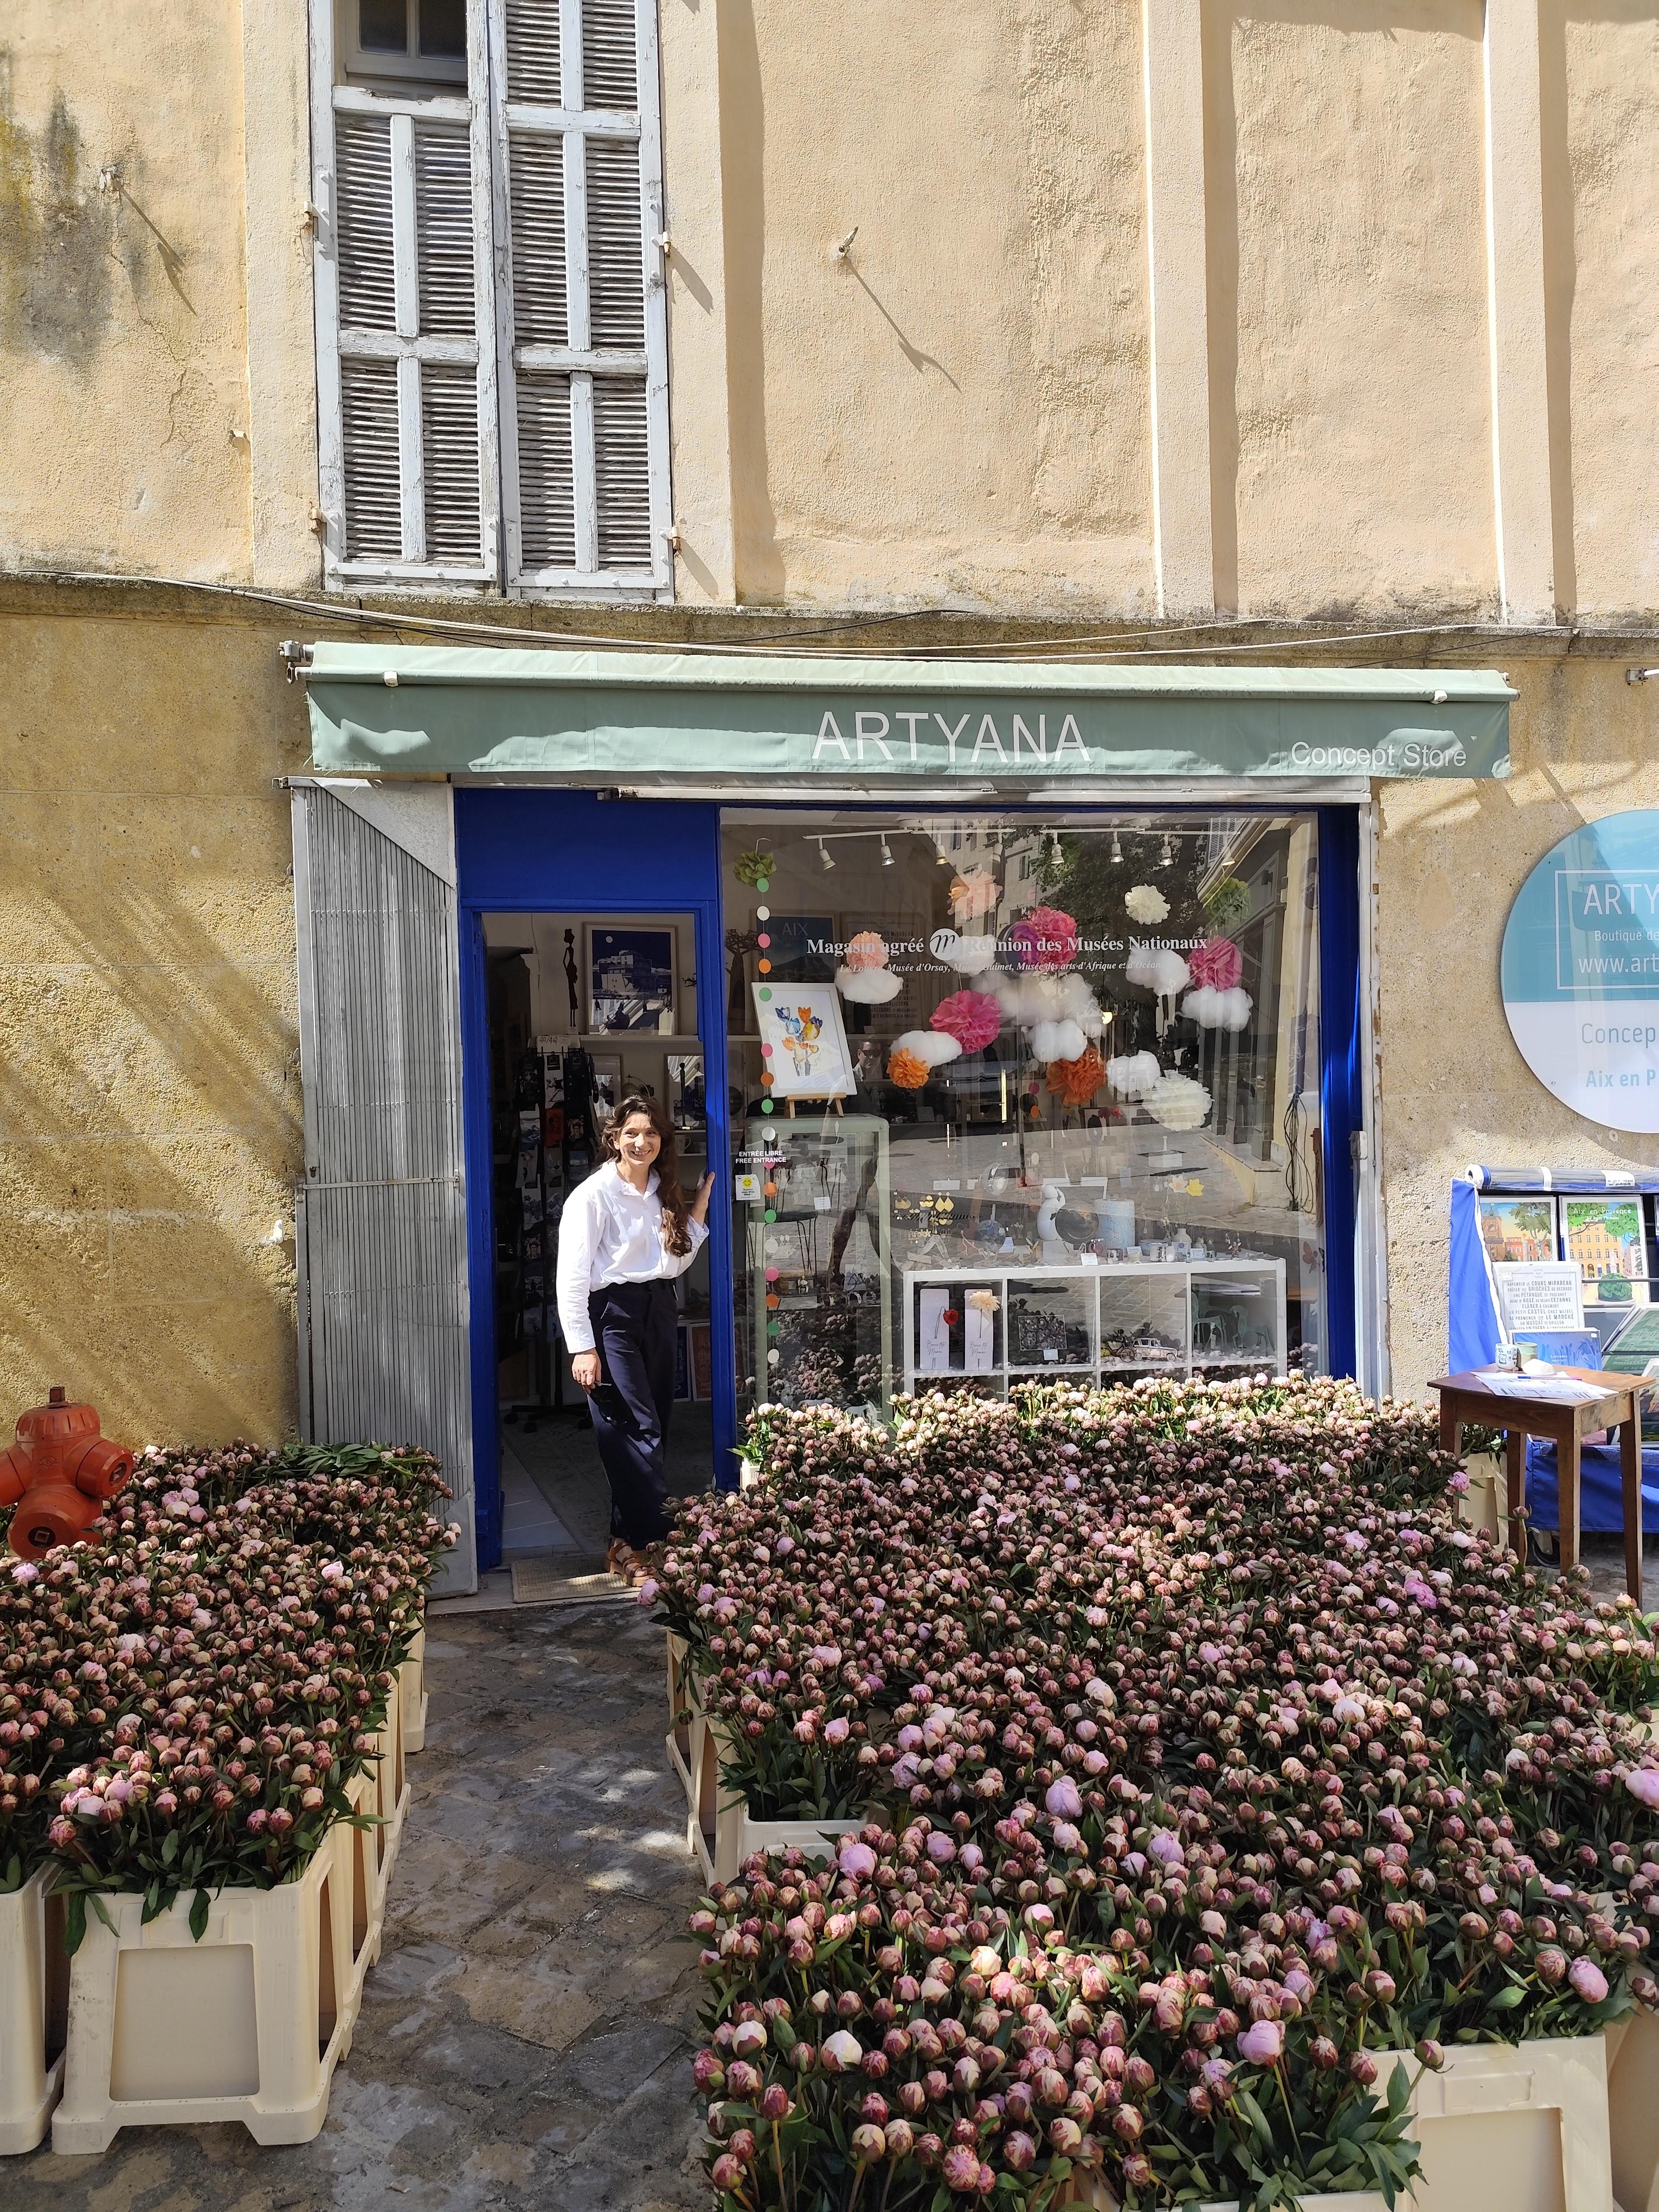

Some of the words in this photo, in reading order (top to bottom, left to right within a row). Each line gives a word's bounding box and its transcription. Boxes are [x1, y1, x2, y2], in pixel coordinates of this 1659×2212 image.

[811, 711, 1091, 762] ARTYANA
[1291, 741, 1395, 770] Concept
[1403, 743, 1467, 767] Store
[1583, 883, 1659, 915] ARTY
[781, 922, 808, 936] AIX
[1594, 930, 1642, 943] Boutique
[806, 938, 876, 957] Magasin
[883, 937, 924, 956] agréé
[1036, 937, 1062, 951] des
[1066, 936, 1124, 951] Musées
[1128, 935, 1208, 949] Nationaux
[887, 963, 914, 972] Musée
[916, 963, 950, 973] d'Orsay,
[1016, 962, 1043, 971] Musée
[1078, 961, 1116, 972] d'Afrique
[1578, 953, 1659, 974] www.art
[1581, 1023, 1656, 1049] Concep
[1585, 1070, 1613, 1088] Aix
[1619, 1073, 1639, 1087] en
[1647, 1069, 1656, 1086] P
